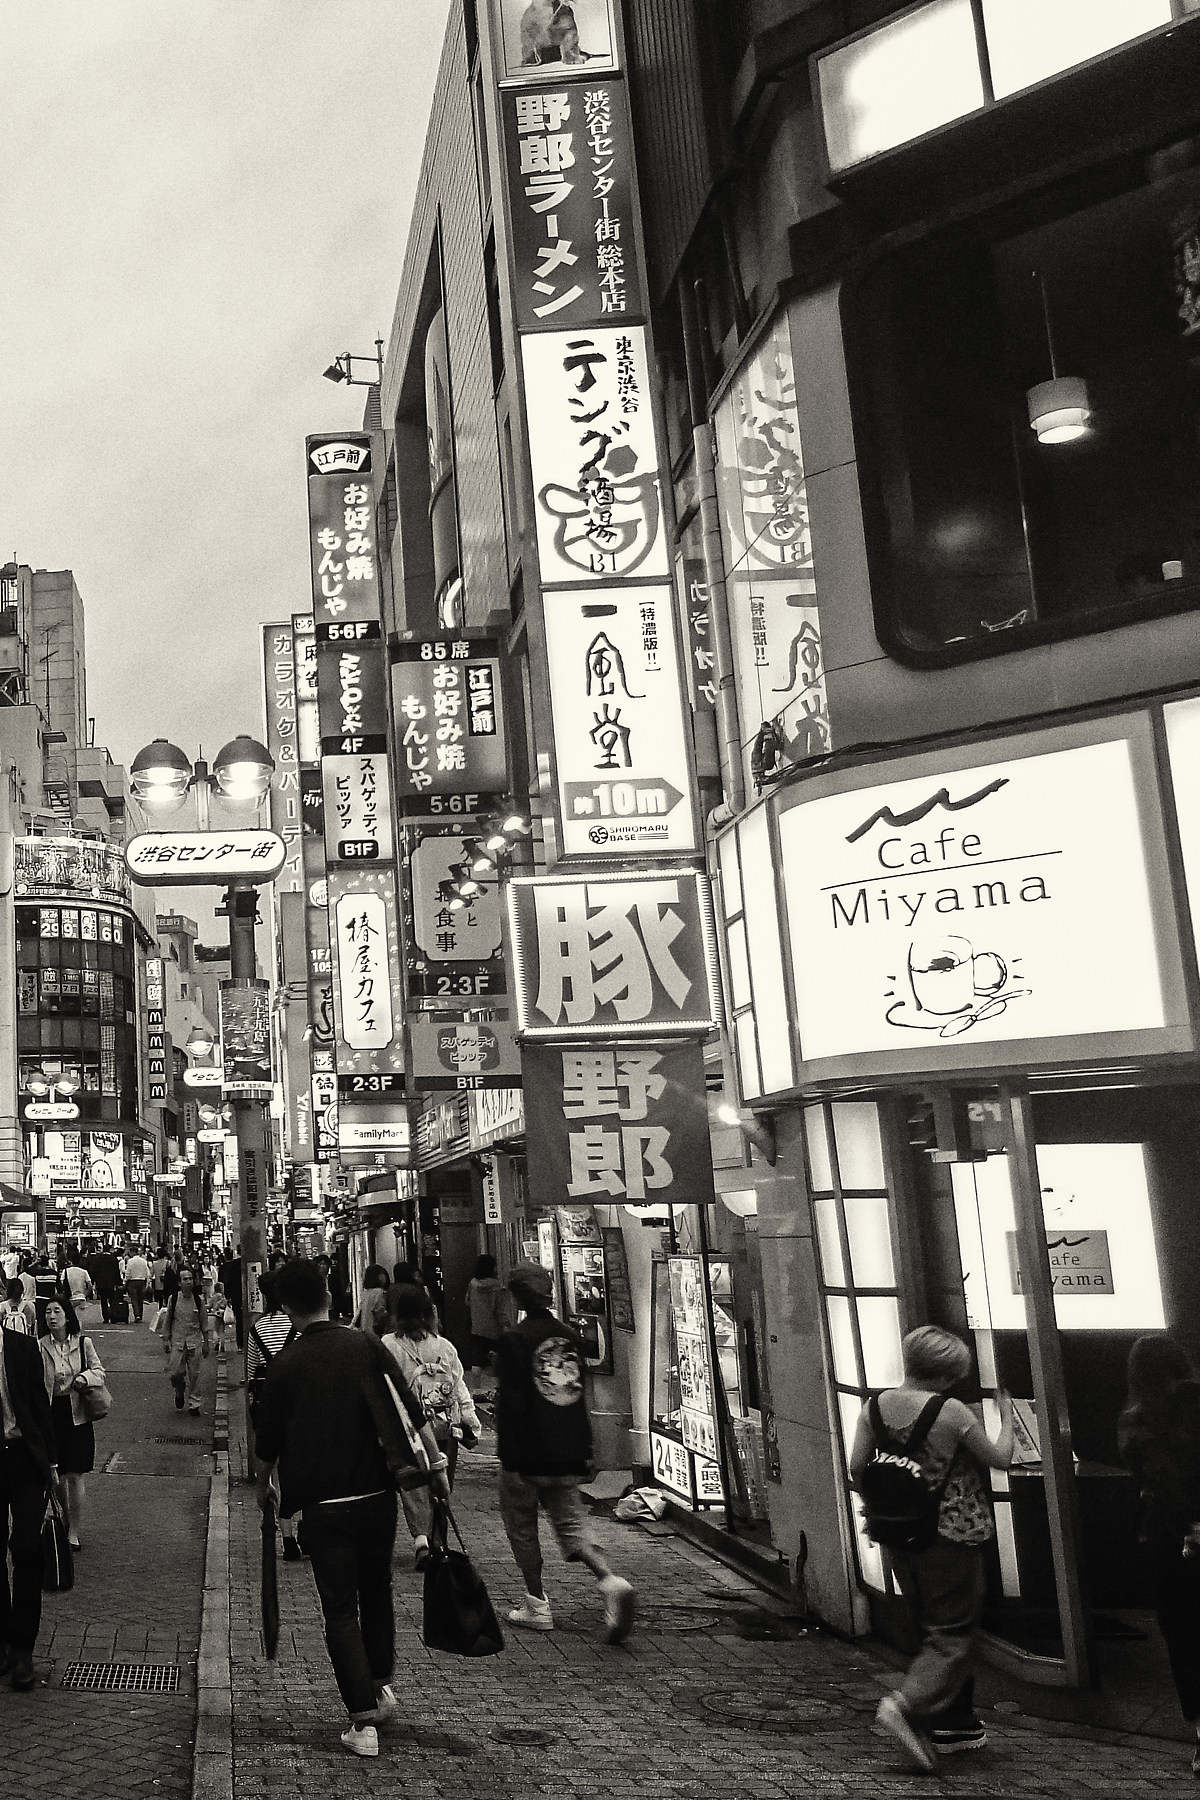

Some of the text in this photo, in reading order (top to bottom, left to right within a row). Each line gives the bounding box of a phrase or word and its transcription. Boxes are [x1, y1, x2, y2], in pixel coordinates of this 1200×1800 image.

[515, 92, 584, 319] 野郎ラーメン
[583, 90, 627, 313] 渋谷センター街 総本店
[615, 336, 640, 413] 東京渋谷
[317, 449, 360, 466] 江戸前
[563, 339, 631, 543] テング酒場
[343, 483, 374, 580] お好み焼
[317, 528, 348, 616] もんじゃ
[421, 641, 469, 660] 85席
[433, 664, 465, 771] お好み焼
[468, 668, 494, 734] 江戸前
[581, 604, 646, 769] 一風堂
[341, 738, 363, 752] 4F
[401, 695, 432, 791] もんじゃ
[336, 776, 352, 829] ピッツァ
[360, 758, 377, 837] スパゲッティ
[135, 842, 277, 862] 渋谷センター街
[344, 842, 373, 856] B1F
[610, 834, 636, 842] BASE
[877, 828, 983, 869] Cafe
[831, 875, 1052, 929] Miyama
[345, 912, 379, 1032] 椿屋カフェ
[533, 880, 693, 1025] 豚
[441, 1036, 495, 1048] スパゲッティ
[457, 1077, 485, 1089] B1F
[562, 1050, 674, 1199] 野郎
[1050, 1252, 1081, 1266] afe
